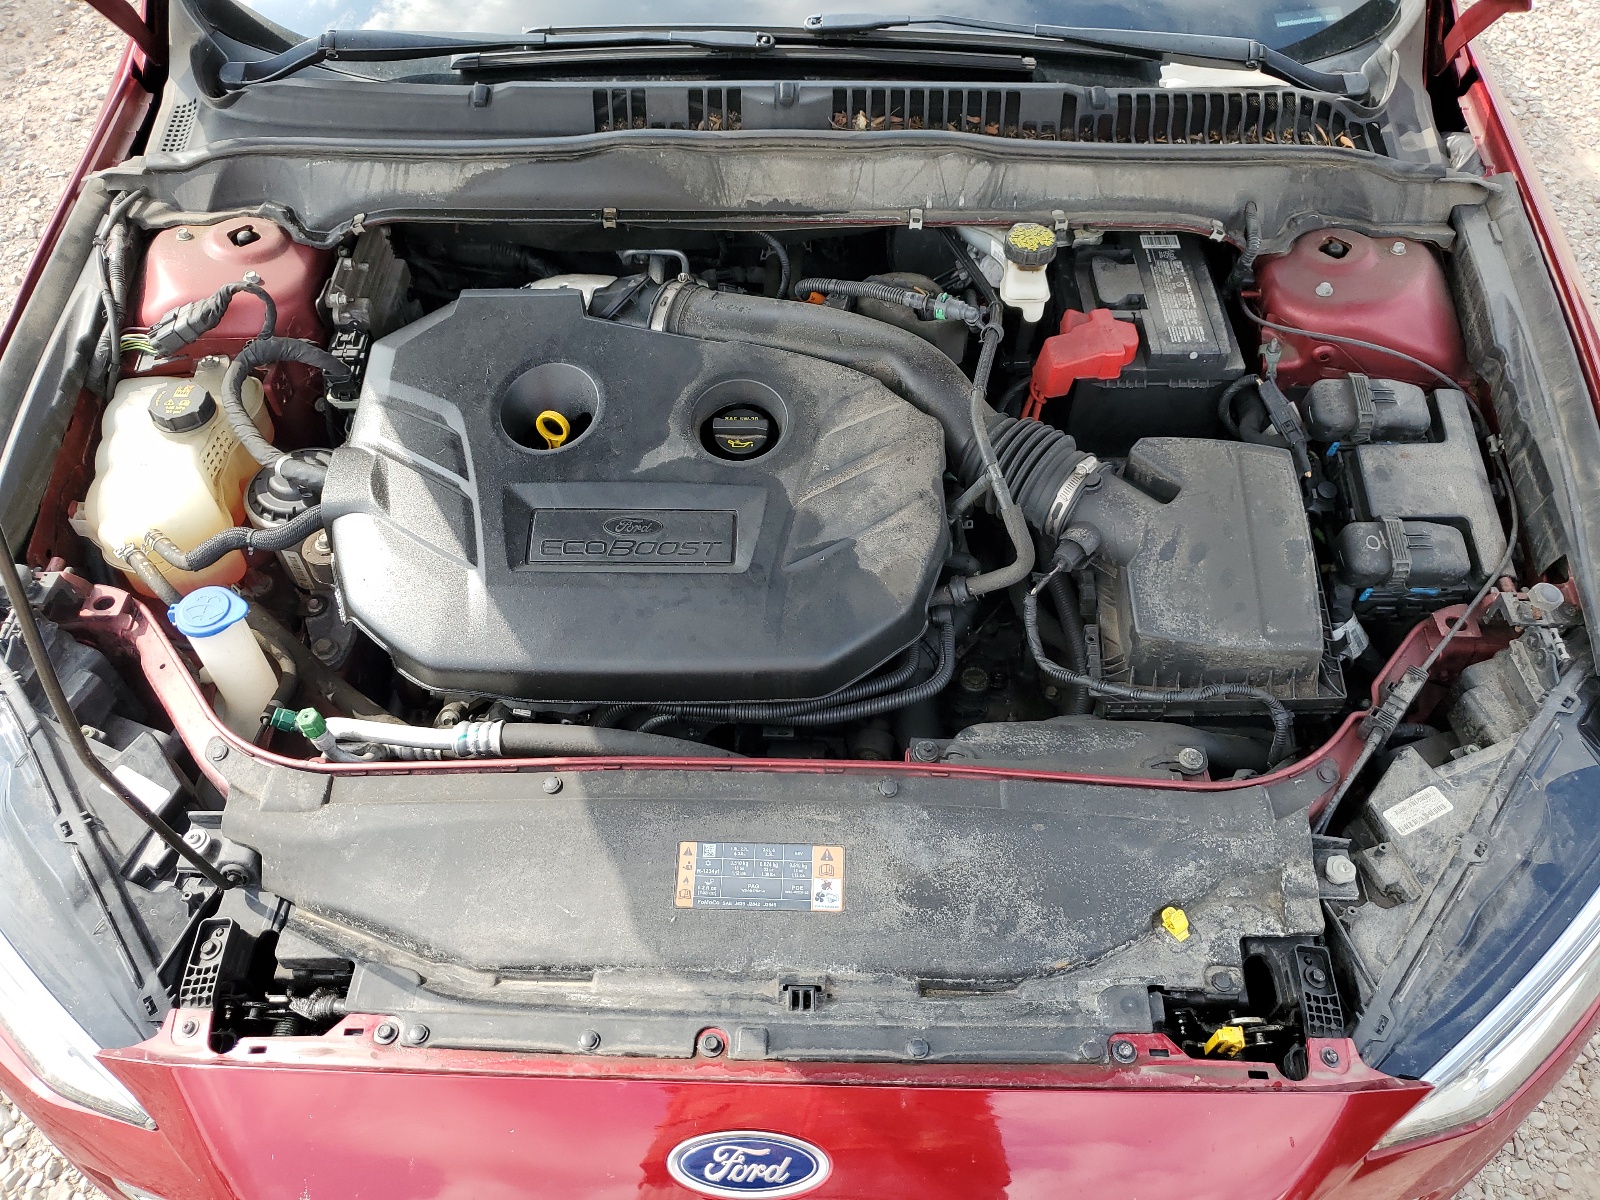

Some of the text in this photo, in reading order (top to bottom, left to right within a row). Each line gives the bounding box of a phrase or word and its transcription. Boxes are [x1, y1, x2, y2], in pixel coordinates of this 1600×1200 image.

[614, 518, 653, 534] Ford
[540, 538, 723, 557] ECOBOOST
[703, 1145, 793, 1184] Ford
